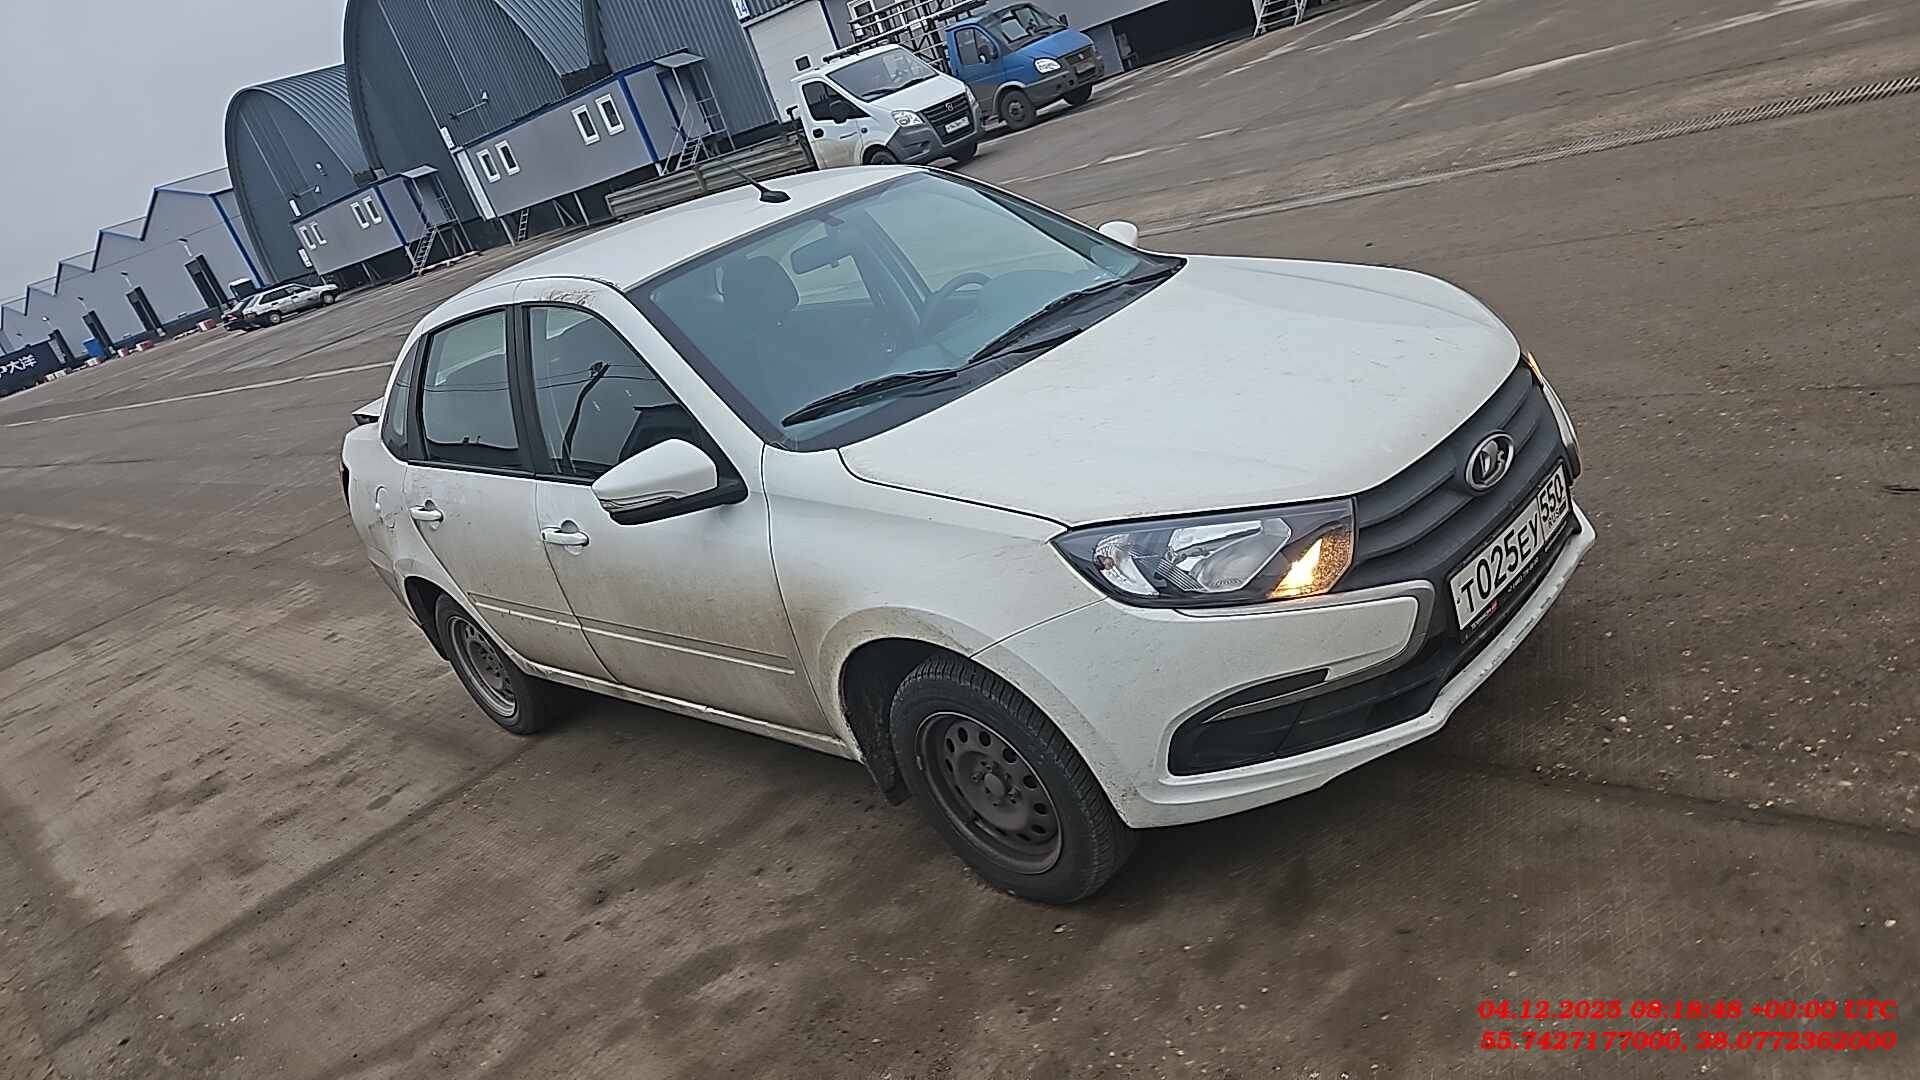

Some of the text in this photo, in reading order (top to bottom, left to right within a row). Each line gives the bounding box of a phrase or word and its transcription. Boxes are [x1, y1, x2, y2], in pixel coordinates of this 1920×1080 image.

[735, 1, 748, 16] 14
[1461, 512, 1539, 613] Т025ЕУ
[1540, 473, 1563, 522] 550
